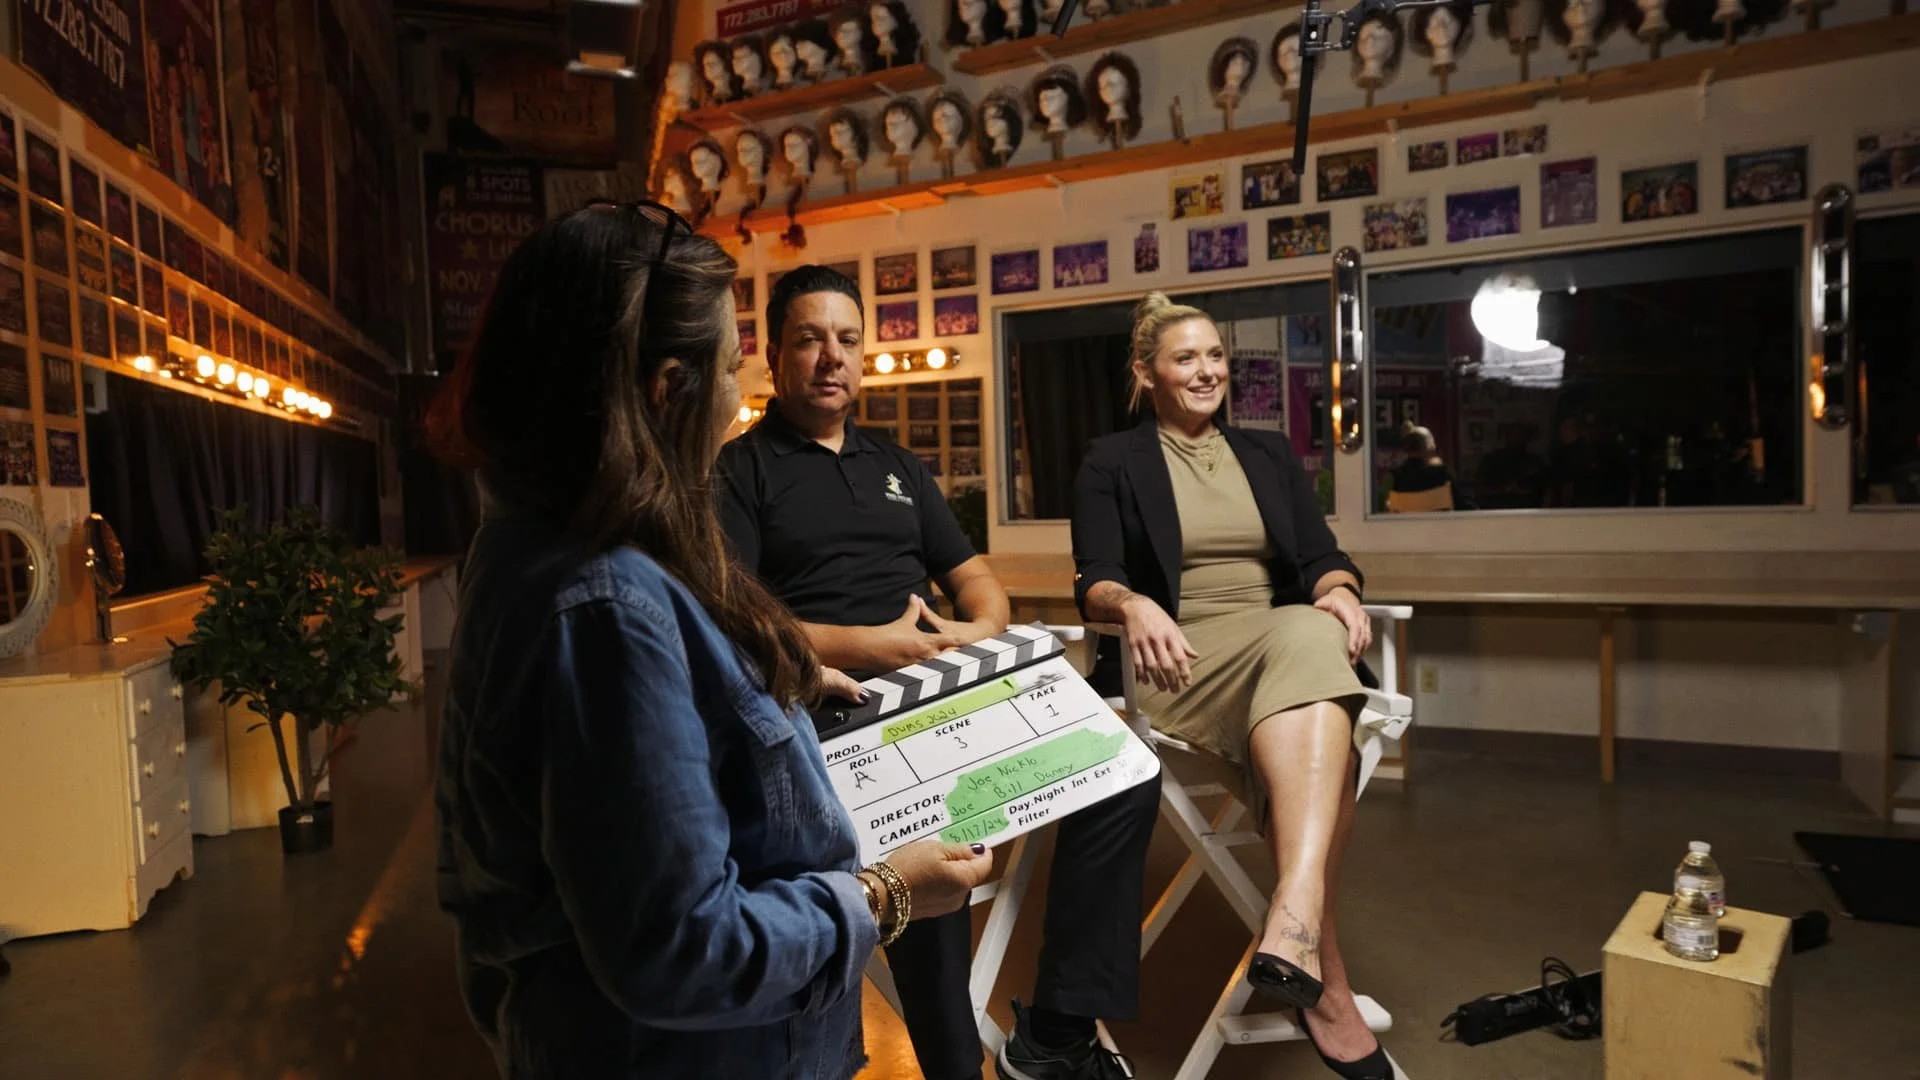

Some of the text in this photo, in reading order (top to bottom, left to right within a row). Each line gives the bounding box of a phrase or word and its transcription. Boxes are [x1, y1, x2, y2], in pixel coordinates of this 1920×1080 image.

[481, 174, 532, 193] SPOTS
[434, 211, 534, 237] CHORUS
[1029, 685, 1057, 701] TAKE
[1044, 703, 1060, 718] 1
[935, 718, 972, 738] SCENE
[953, 736, 969, 749] 3
[826, 744, 865, 763] PROD.
[849, 753, 880, 771] ROLL
[854, 770, 877, 790] A
[968, 775, 993, 791] Joe
[1072, 776, 1088, 788] Int
[1094, 767, 1111, 778] Ext
[870, 793, 946, 830] DIRECTOR:
[1018, 807, 1050, 827] Filter
[879, 813, 945, 846] CAMERA:
